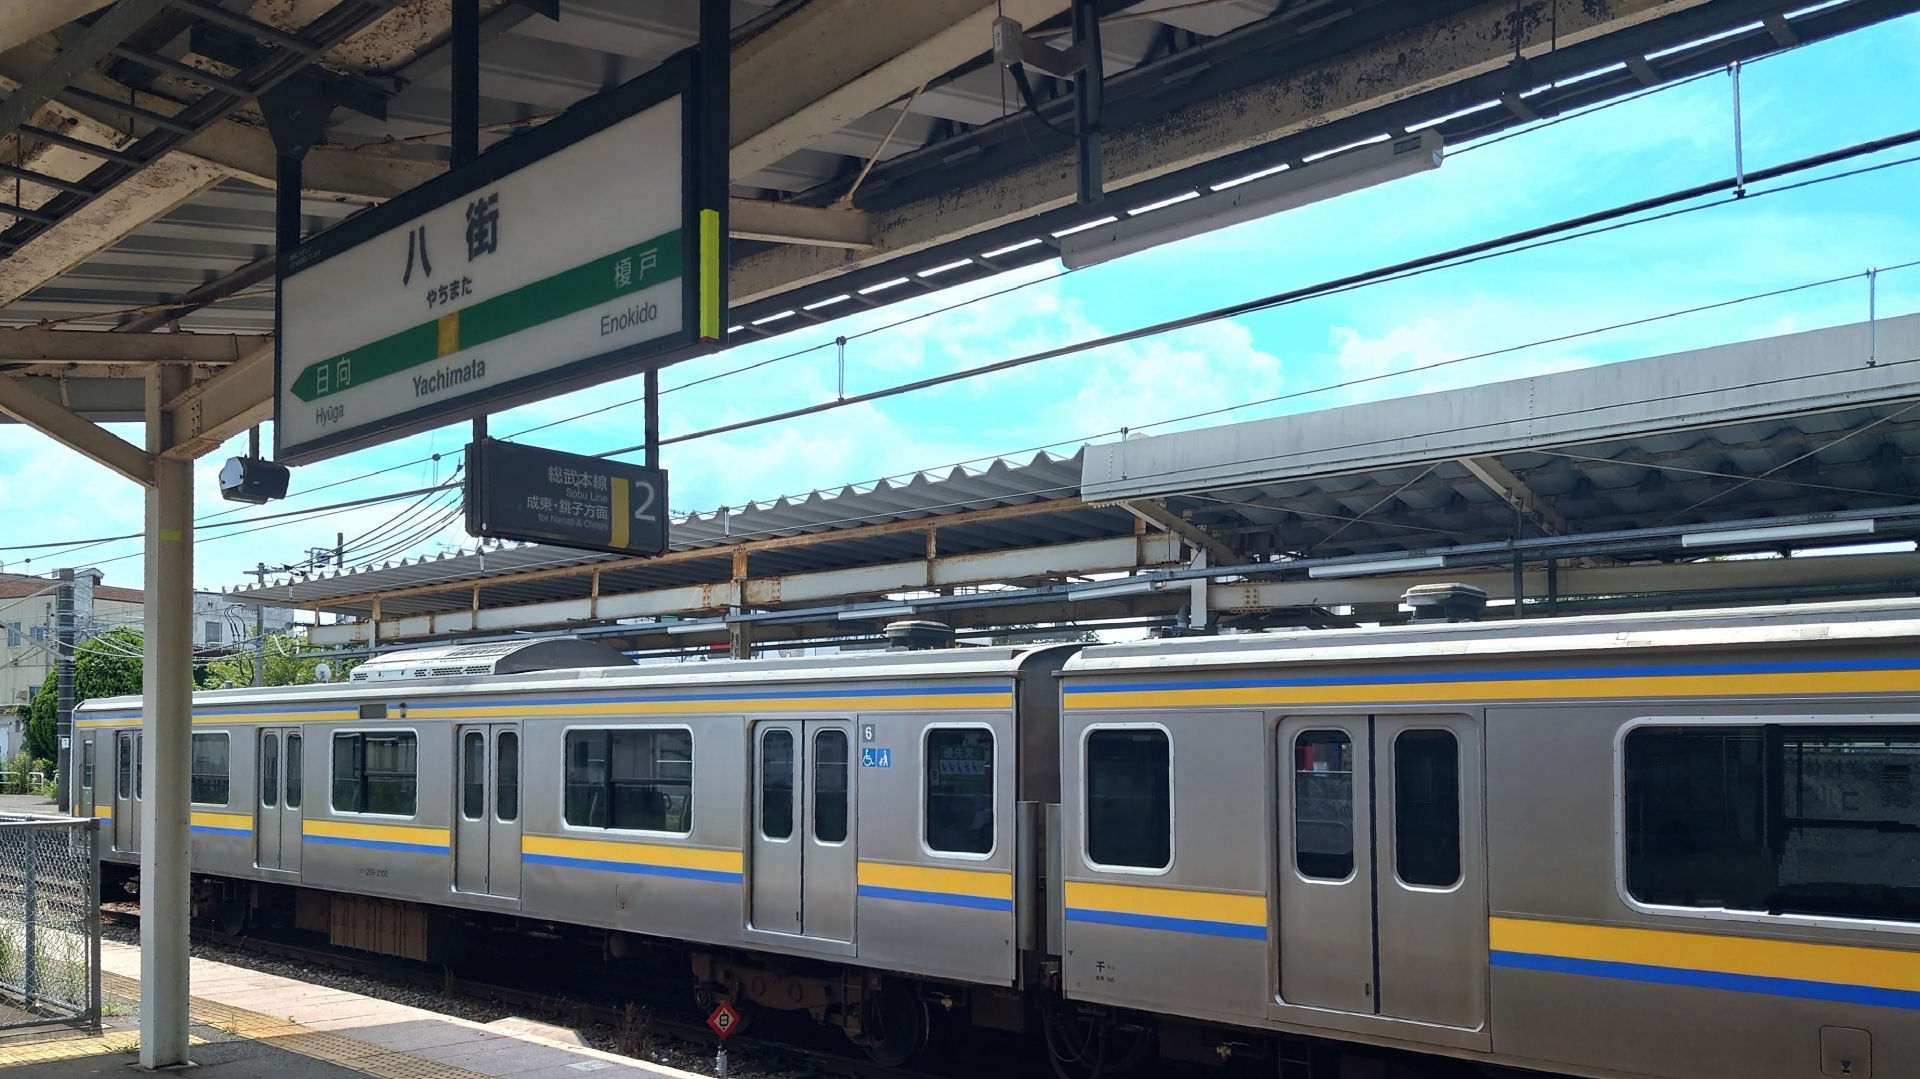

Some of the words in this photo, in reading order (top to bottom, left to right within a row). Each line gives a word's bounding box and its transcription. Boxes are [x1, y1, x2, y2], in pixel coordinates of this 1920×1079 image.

[402, 192, 499, 287] 八街
[613, 247, 658, 290] 榎戸
[426, 276, 473, 309] やちまた
[600, 302, 658, 337] Enokido
[316, 357, 351, 396] 日向
[412, 358, 486, 398] Yachimata
[316, 404, 345, 426] Hyūga
[548, 466, 608, 491] 総武本線
[590, 491, 608, 503] Line
[634, 481, 656, 522] 2
[538, 513, 549, 522] for
[550, 514, 574, 525] Naruto
[576, 518, 582, 527] &
[865, 726, 872, 740] 6
